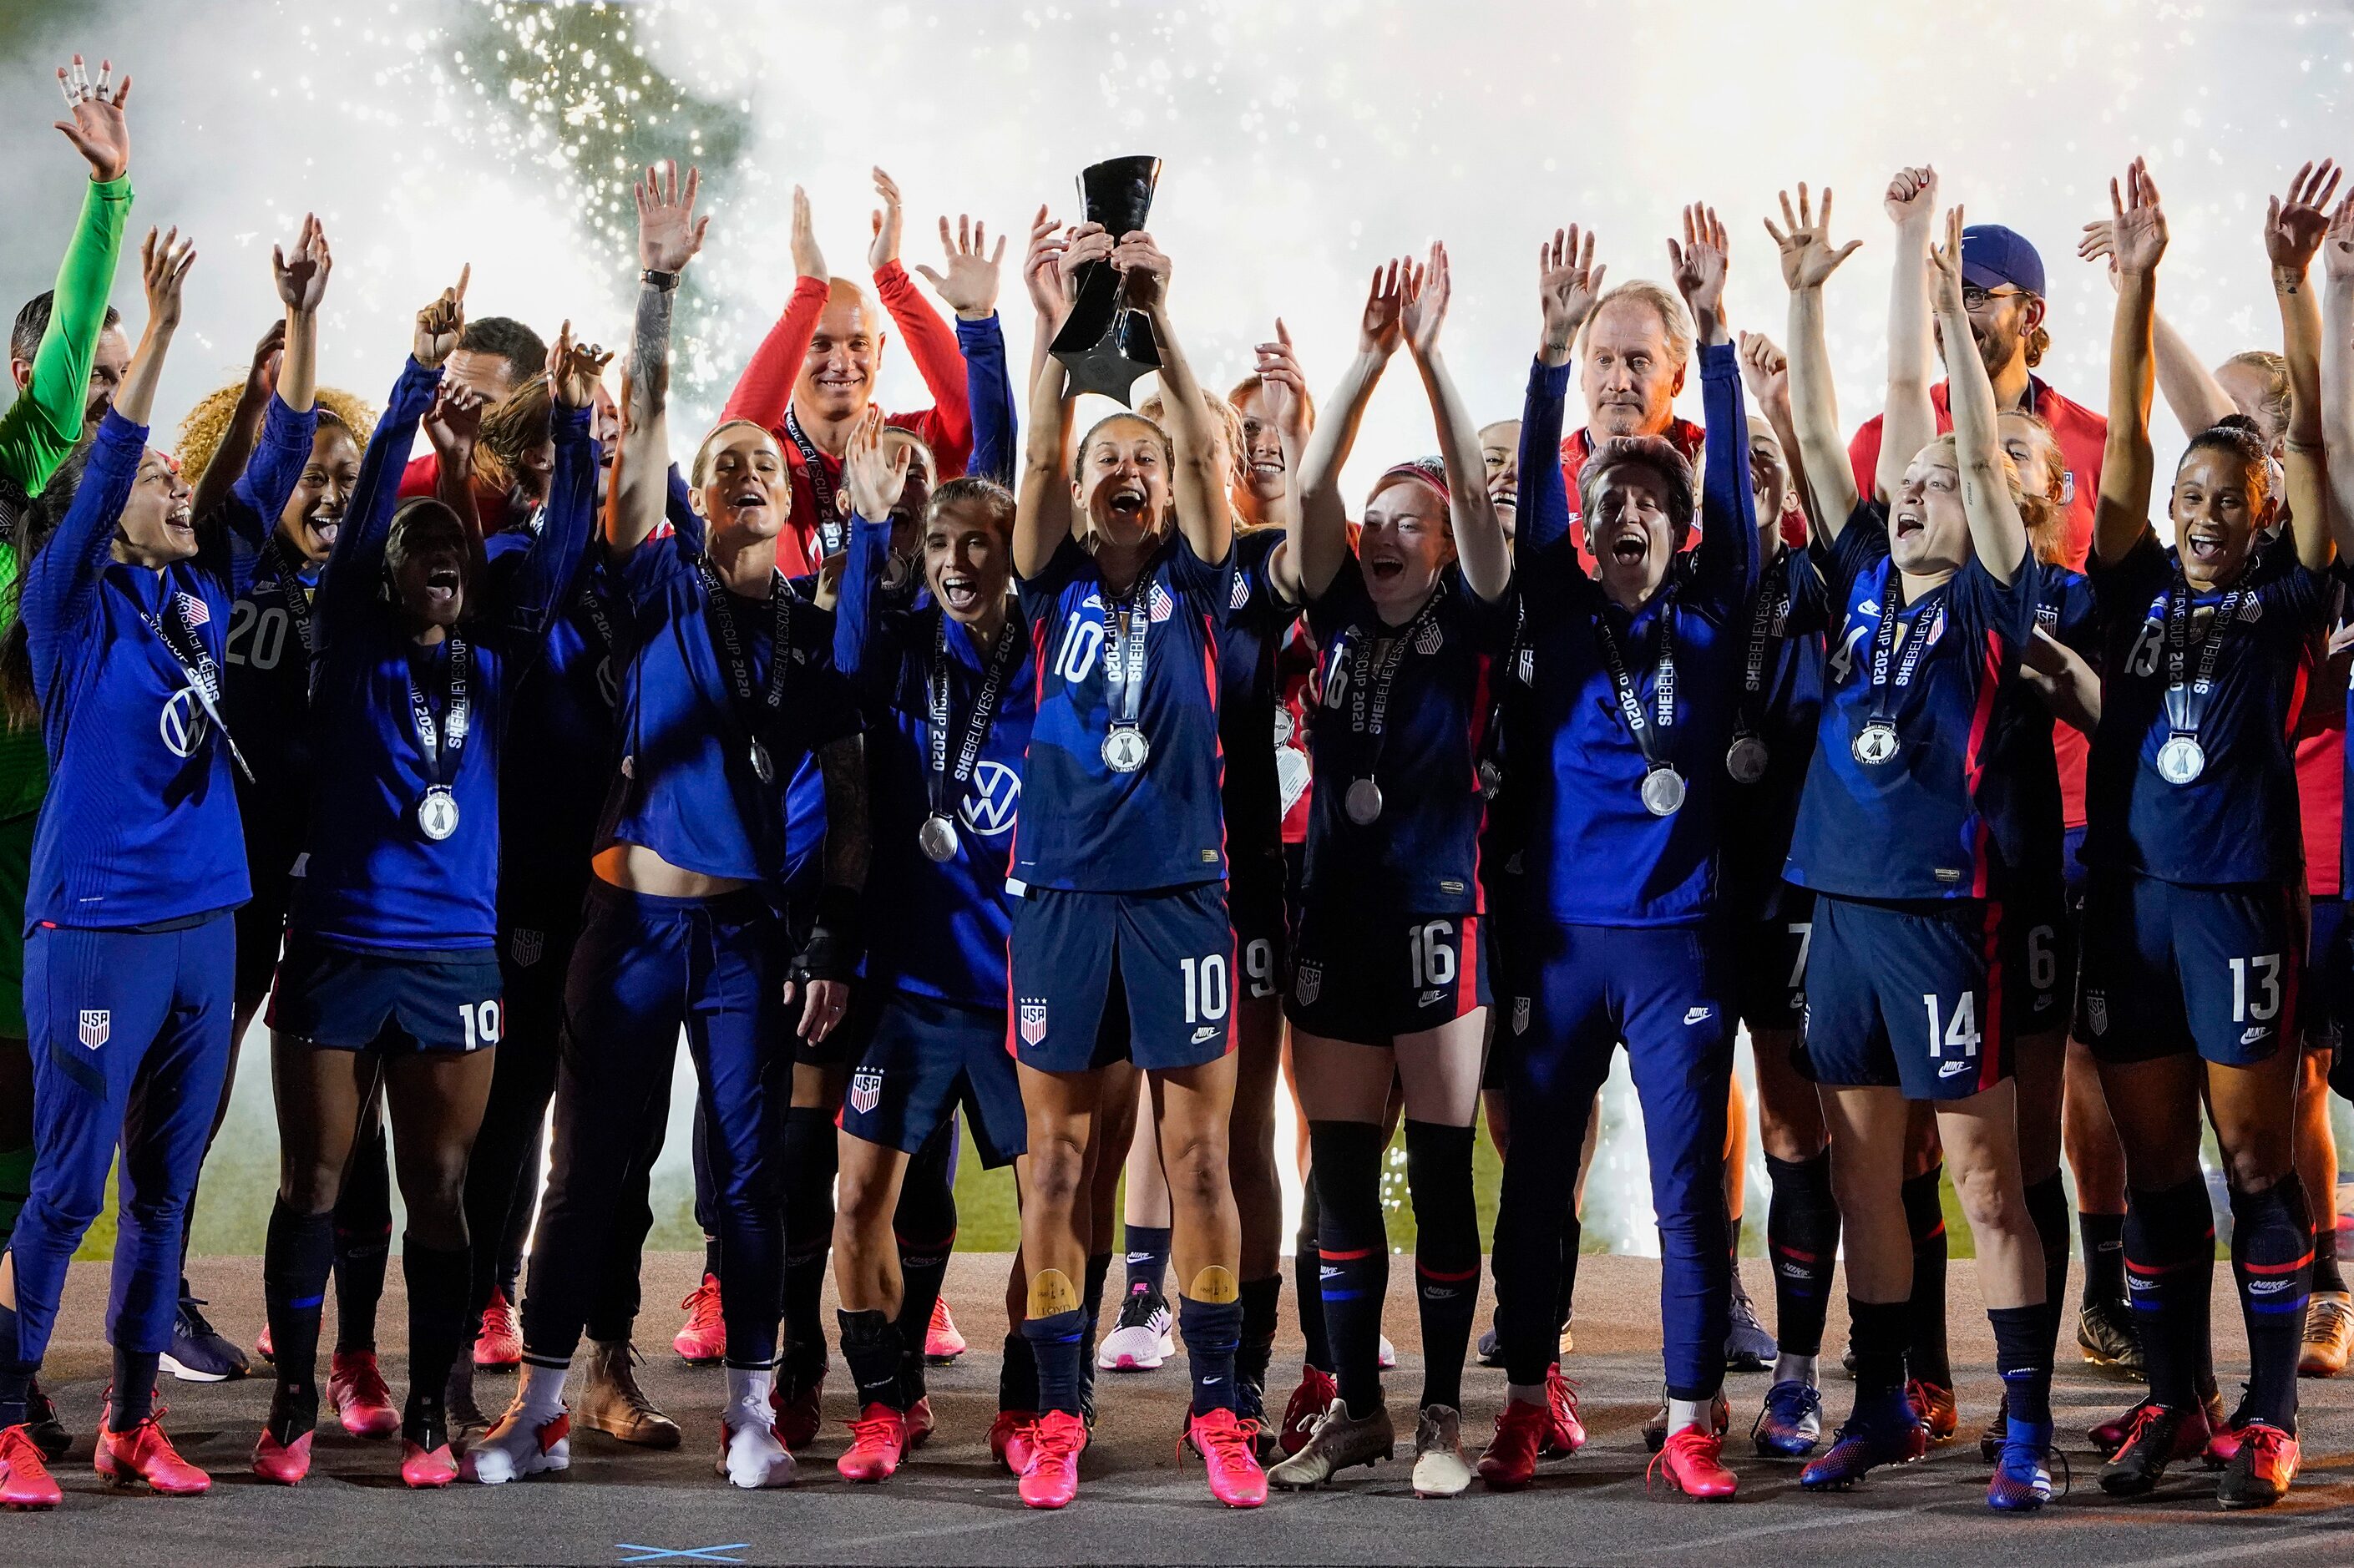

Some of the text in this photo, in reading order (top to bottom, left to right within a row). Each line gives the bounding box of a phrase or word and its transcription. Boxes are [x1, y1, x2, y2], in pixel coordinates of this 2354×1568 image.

[225, 599, 290, 670] 20
[1054, 610, 1104, 683] 10
[732, 658, 751, 698] 2020
[1105, 641, 1122, 682] 2020
[1873, 649, 1889, 685] 2020
[2169, 652, 2184, 691] 2020
[448, 638, 468, 749] SHEBELIEVESCUP
[1352, 690, 1365, 732] 2020
[1620, 688, 1645, 731] 2020
[414, 706, 438, 746] 2020
[954, 664, 1002, 781] SHEBELIEVESCUP
[932, 730, 946, 771] 2020
[1246, 938, 1277, 999] 9
[1409, 919, 1455, 989] 16
[1788, 923, 1813, 988] 7
[2028, 924, 2056, 989] 6
[1180, 953, 1228, 1024] 10
[1421, 989, 1440, 1000] NIKE
[2229, 953, 2281, 1023] 13
[82, 1012, 108, 1028] USA
[1023, 1007, 1045, 1024] USA
[1195, 1026, 1216, 1038] NIKE
[1688, 1007, 1709, 1018] NIKE
[1923, 990, 1982, 1058] 14
[2246, 1026, 2266, 1038] NIKE
[856, 1076, 878, 1091] USA
[1942, 1060, 1964, 1071] NIKE
[1133, 1282, 1147, 1291] NIKE
[2254, 1278, 2288, 1290] NIKE
